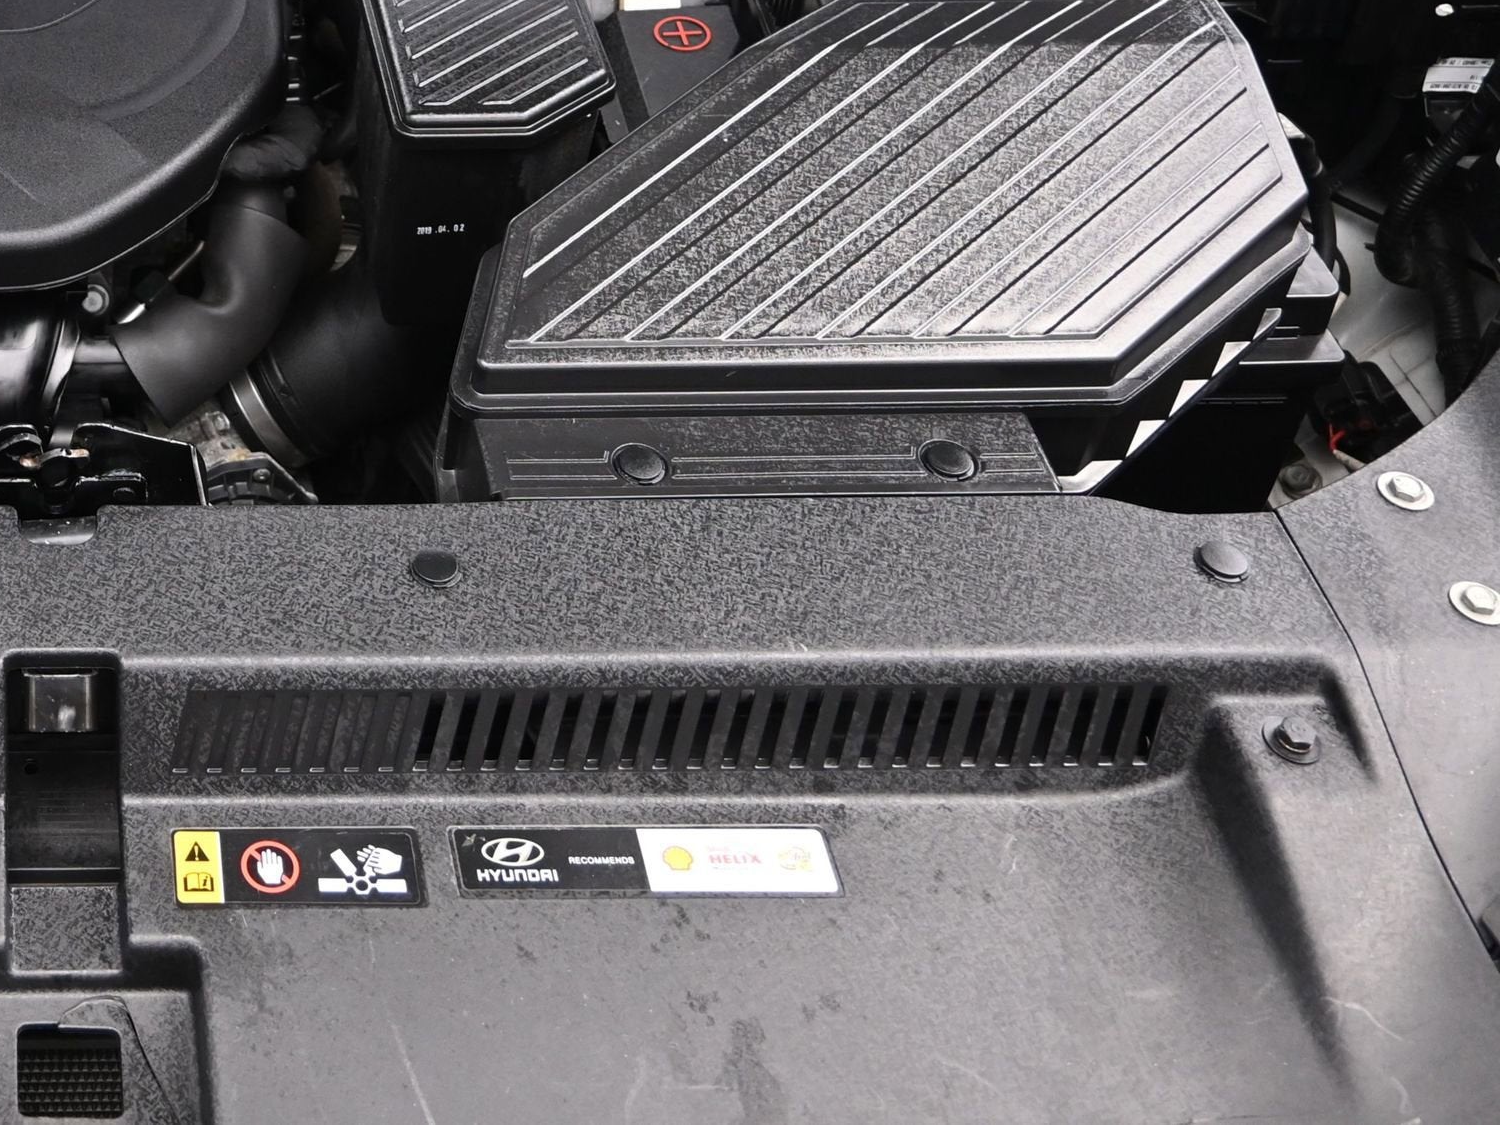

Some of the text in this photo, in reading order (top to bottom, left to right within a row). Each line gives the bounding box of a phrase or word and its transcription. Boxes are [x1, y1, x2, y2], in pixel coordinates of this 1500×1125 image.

[568, 856, 635, 865] RECOMMENDS
[709, 854, 762, 864] HELIX
[477, 868, 559, 882] HYUNDAI
